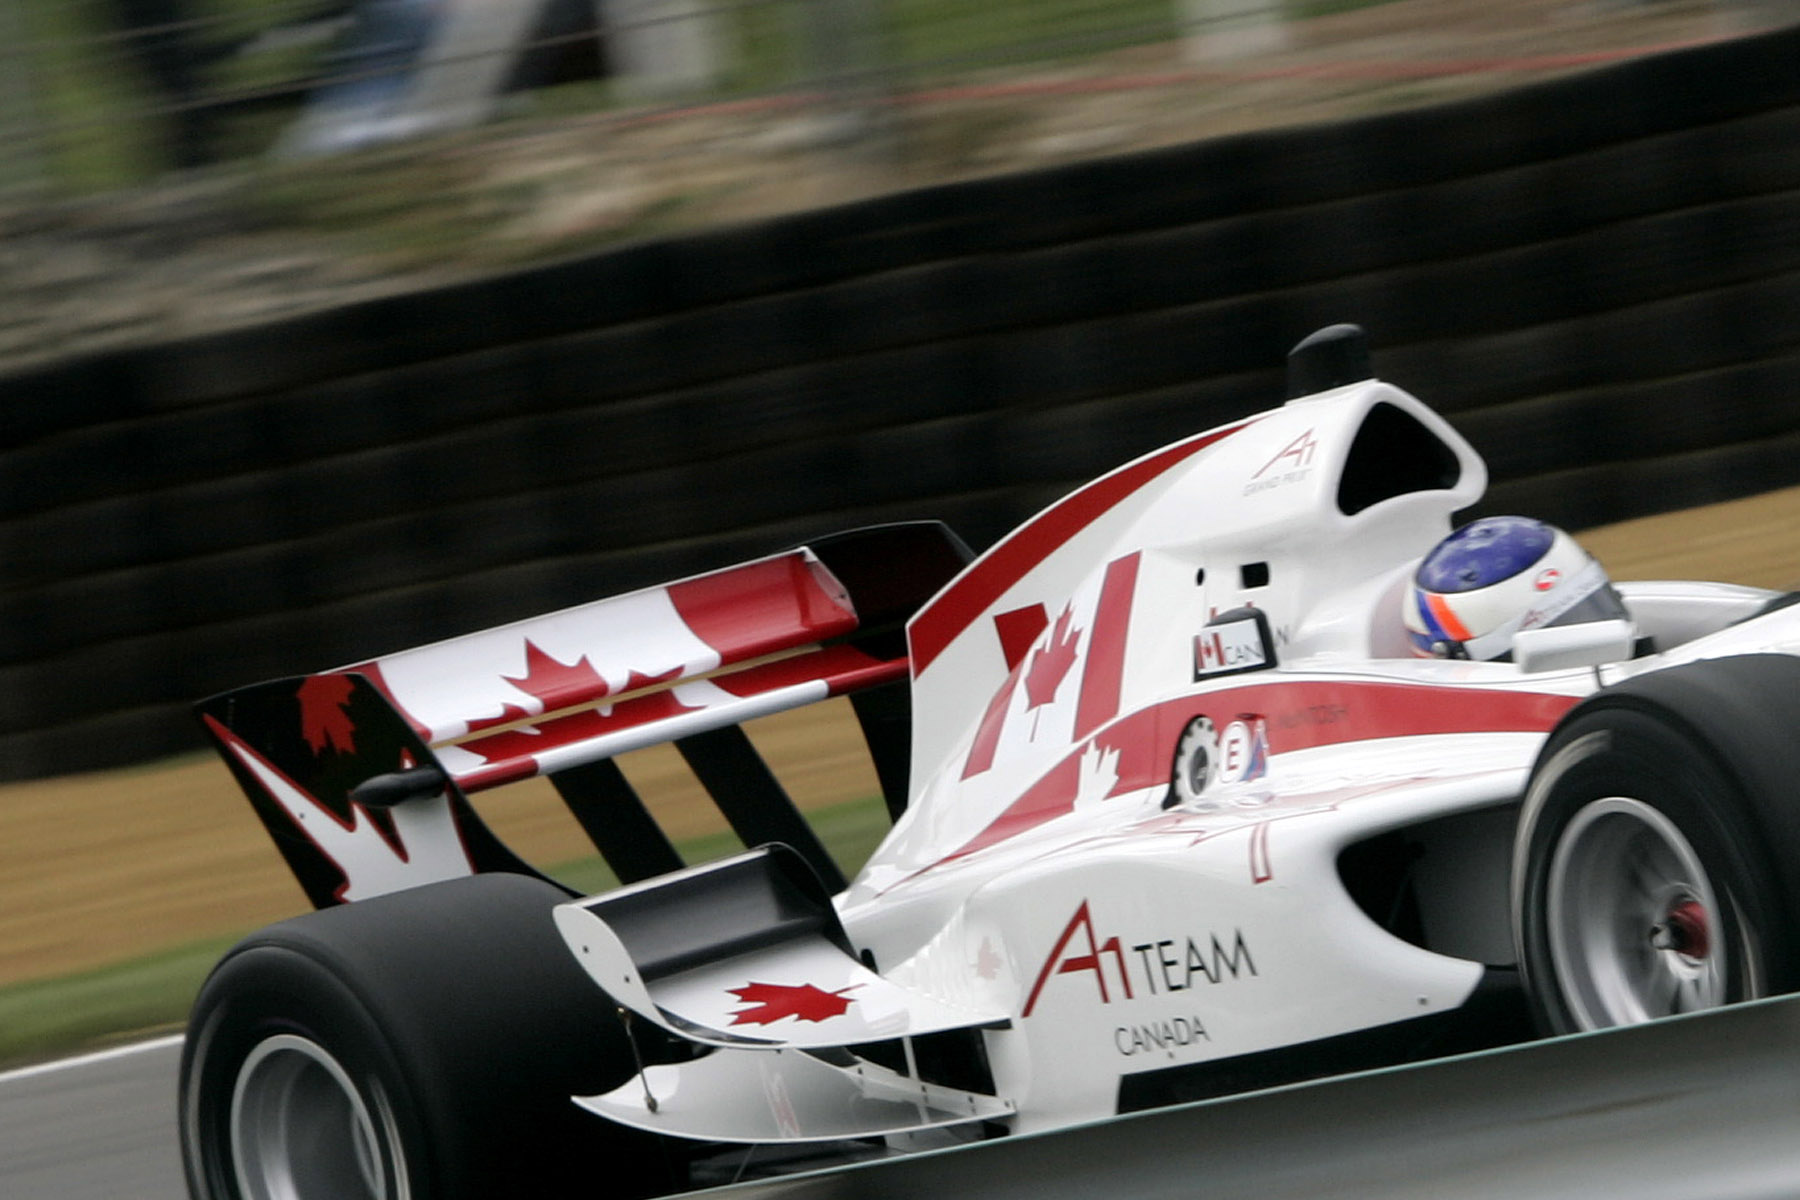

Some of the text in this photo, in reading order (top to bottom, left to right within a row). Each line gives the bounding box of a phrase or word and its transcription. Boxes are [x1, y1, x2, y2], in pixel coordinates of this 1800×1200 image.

[1250, 427, 1319, 480] A1
[1226, 738, 1241, 772] E
[1020, 898, 1258, 1019] A1 TEAM
[1114, 1014, 1212, 1057] CANADA
